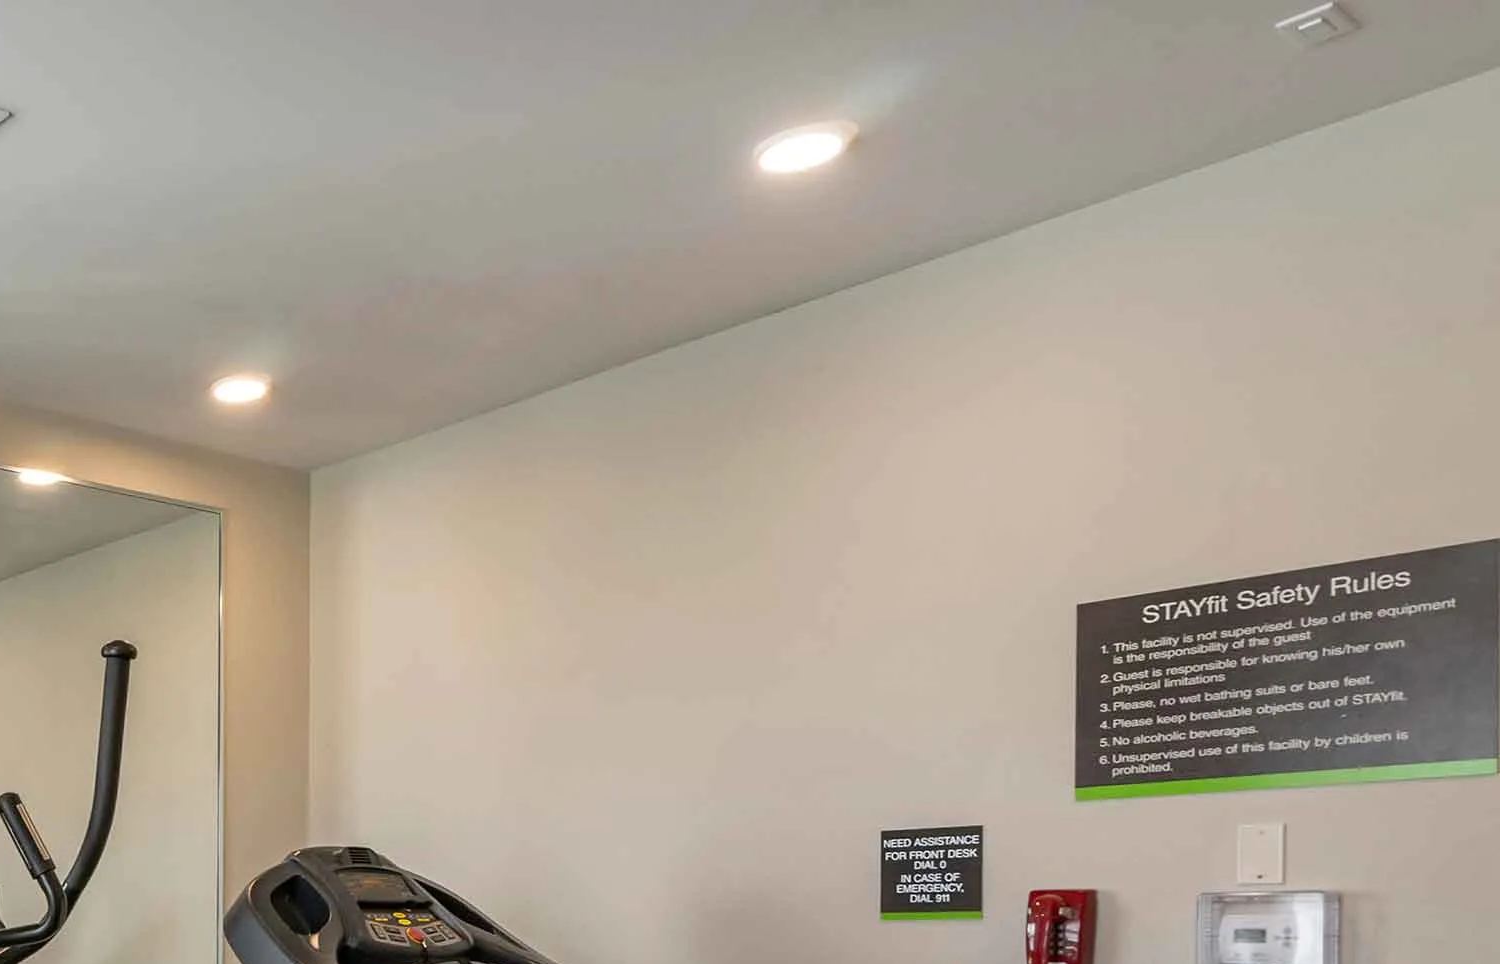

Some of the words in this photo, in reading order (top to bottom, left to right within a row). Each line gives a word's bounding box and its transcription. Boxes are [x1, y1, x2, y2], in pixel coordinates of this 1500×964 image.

[1142, 595, 1228, 623] STAYfit
[1236, 583, 1321, 610] Safety
[1330, 571, 1411, 596] Rules
[1101, 645, 1108, 654] 1.
[1113, 642, 1139, 653] This
[1142, 636, 1180, 649] facility
[1183, 634, 1193, 643] is
[1197, 631, 1217, 641] not
[1301, 617, 1328, 628] Use
[1333, 612, 1348, 623] of
[1350, 610, 1373, 620] the
[1377, 598, 1457, 617] equipment
[1113, 654, 1123, 664] is
[1126, 651, 1145, 663] the
[1149, 642, 1228, 659] responsibility
[1232, 638, 1245, 649] of
[1249, 636, 1269, 647] the
[1274, 630, 1312, 646] guest
[1113, 670, 1149, 682] Guest
[1152, 668, 1163, 677] is
[1165, 659, 1237, 677] responsible
[1241, 656, 1259, 666] for
[1262, 649, 1318, 662] knowing
[1322, 644, 1371, 657] his/her
[1374, 639, 1405, 650] own
[1100, 703, 1111, 713] 3.
[1160, 696, 1176, 706] no
[1178, 694, 1201, 705] wet
[1205, 688, 1252, 701] bathing
[1255, 684, 1286, 696] suits
[1290, 683, 1304, 692] or
[1308, 679, 1339, 690] bare
[1112, 678, 1161, 696] physical
[1164, 673, 1226, 688] limitations
[1100, 720, 1111, 729] 4.
[1113, 718, 1153, 728] Please
[1156, 714, 1186, 725] keep
[1189, 706, 1252, 721] breakable
[1256, 701, 1304, 715] objects
[1308, 699, 1330, 710] out
[1334, 695, 1349, 706] of
[1112, 748, 1195, 763] Unsupervised
[1199, 747, 1222, 756] use
[1226, 744, 1239, 754] of
[1242, 741, 1265, 752] this
[1269, 739, 1310, 751] facility
[1314, 736, 1332, 748] by
[1335, 731, 1391, 745] children
[1396, 731, 1409, 740] is
[1113, 737, 1130, 746] No
[1133, 730, 1186, 744] alcoholic
[1112, 763, 1172, 778] prohibited.
[884, 838, 912, 848] NEED
[914, 835, 980, 847] ASSISTANCE
[885, 852, 907, 860] FOR
[909, 850, 945, 859] FRONT
[948, 849, 978, 858] DESK
[914, 861, 938, 869] DIAL
[901, 874, 911, 883] IN
[913, 873, 942, 883] CASE
[944, 873, 960, 882] OF
[910, 895, 933, 903] DIAL
[936, 894, 950, 902] 911
